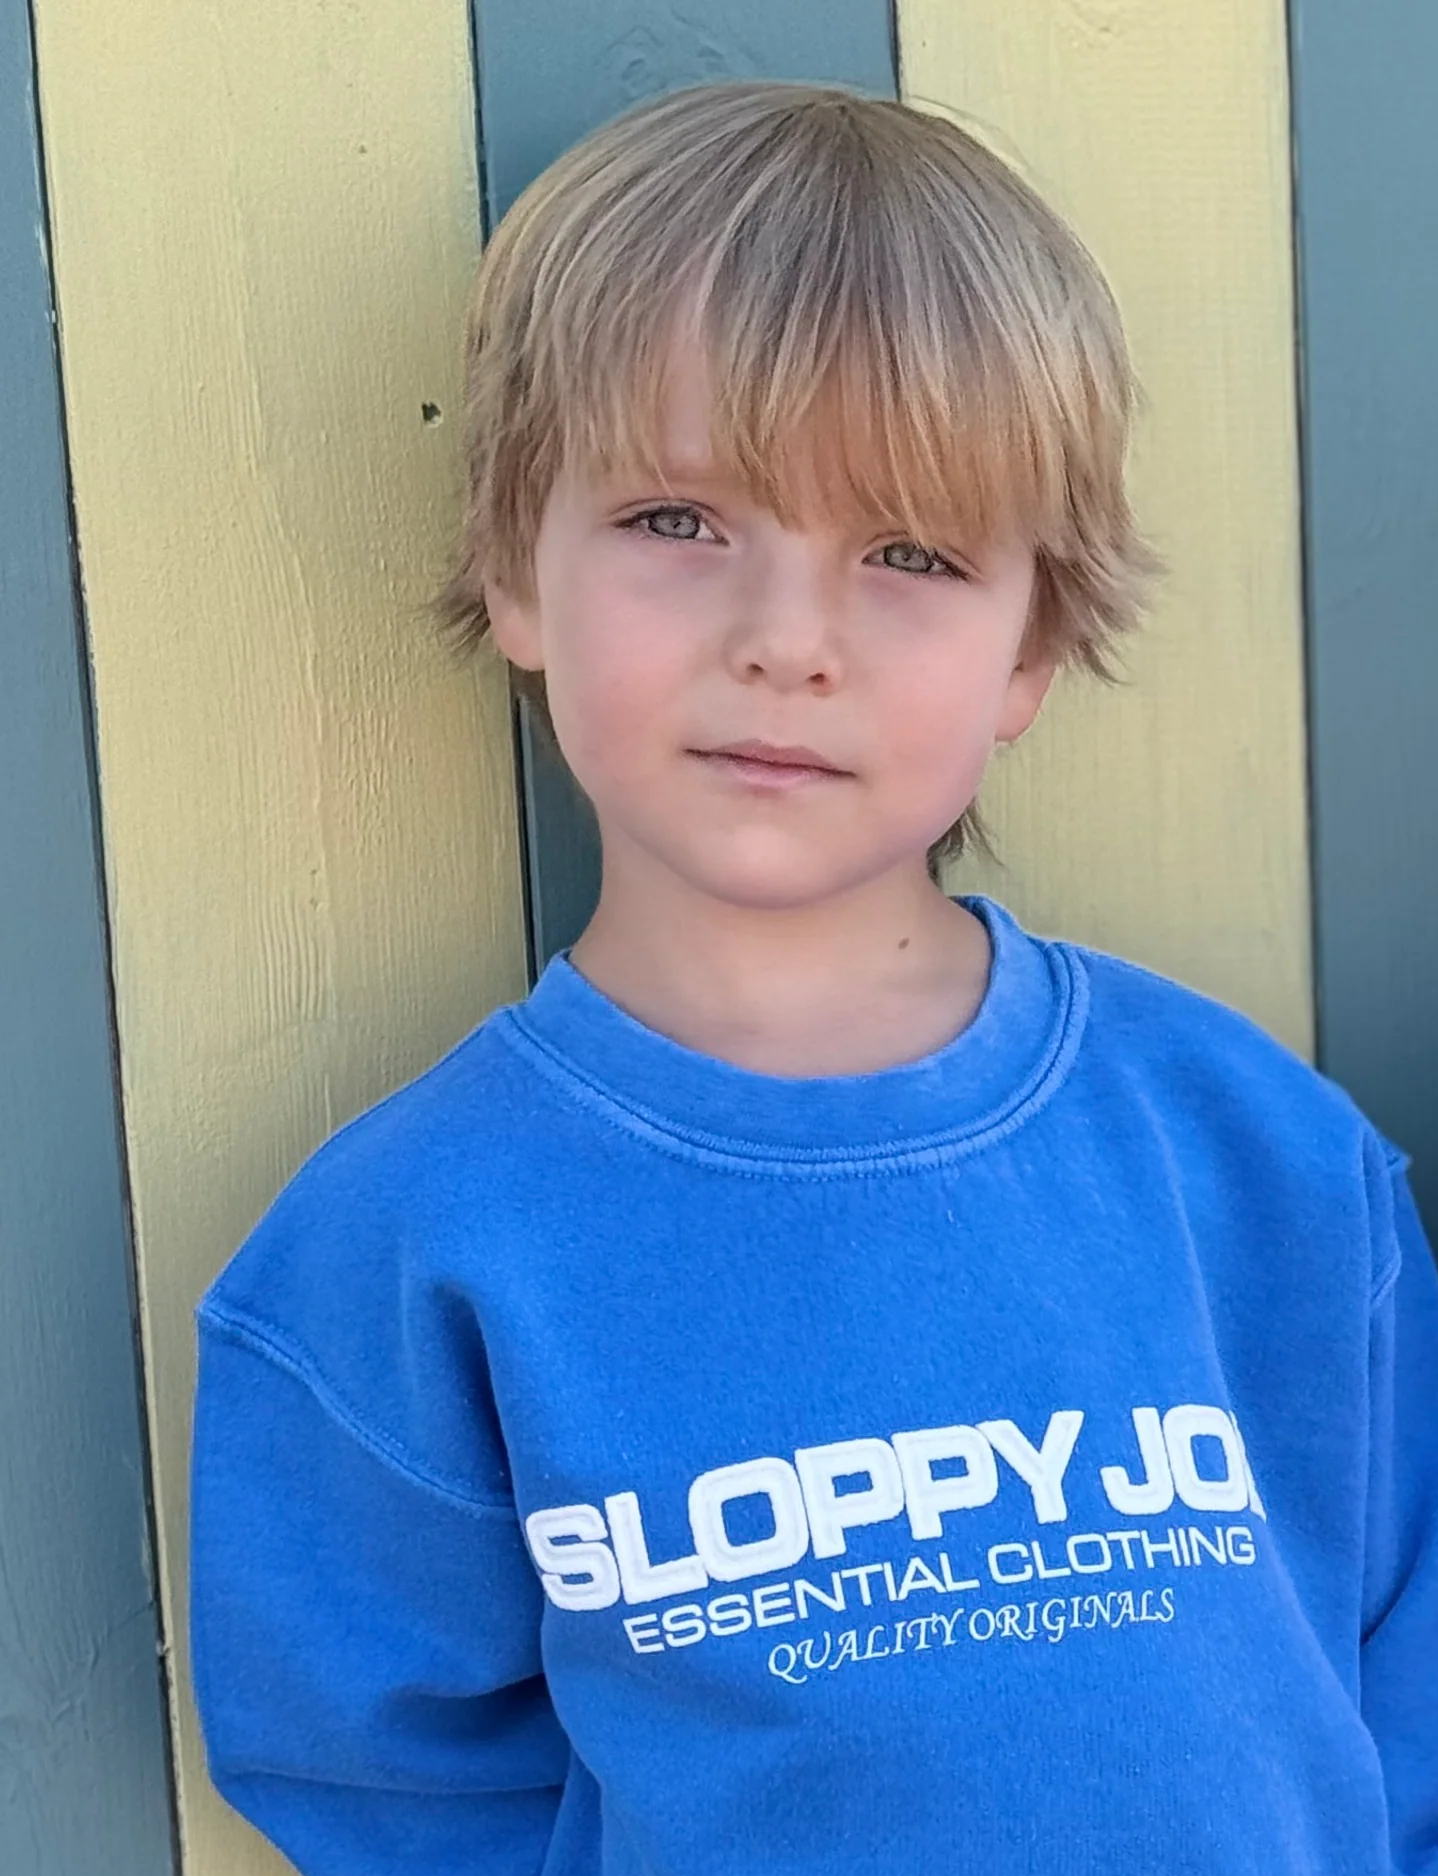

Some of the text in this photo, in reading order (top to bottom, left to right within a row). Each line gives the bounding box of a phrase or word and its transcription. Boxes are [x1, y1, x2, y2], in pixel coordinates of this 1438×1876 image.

[526, 1404, 1266, 1611] SLOPPY JO
[623, 1525, 1256, 1653] ESSENTIAL CLOTHING
[767, 1588, 1175, 1684] QUALITY ORIGINALS
